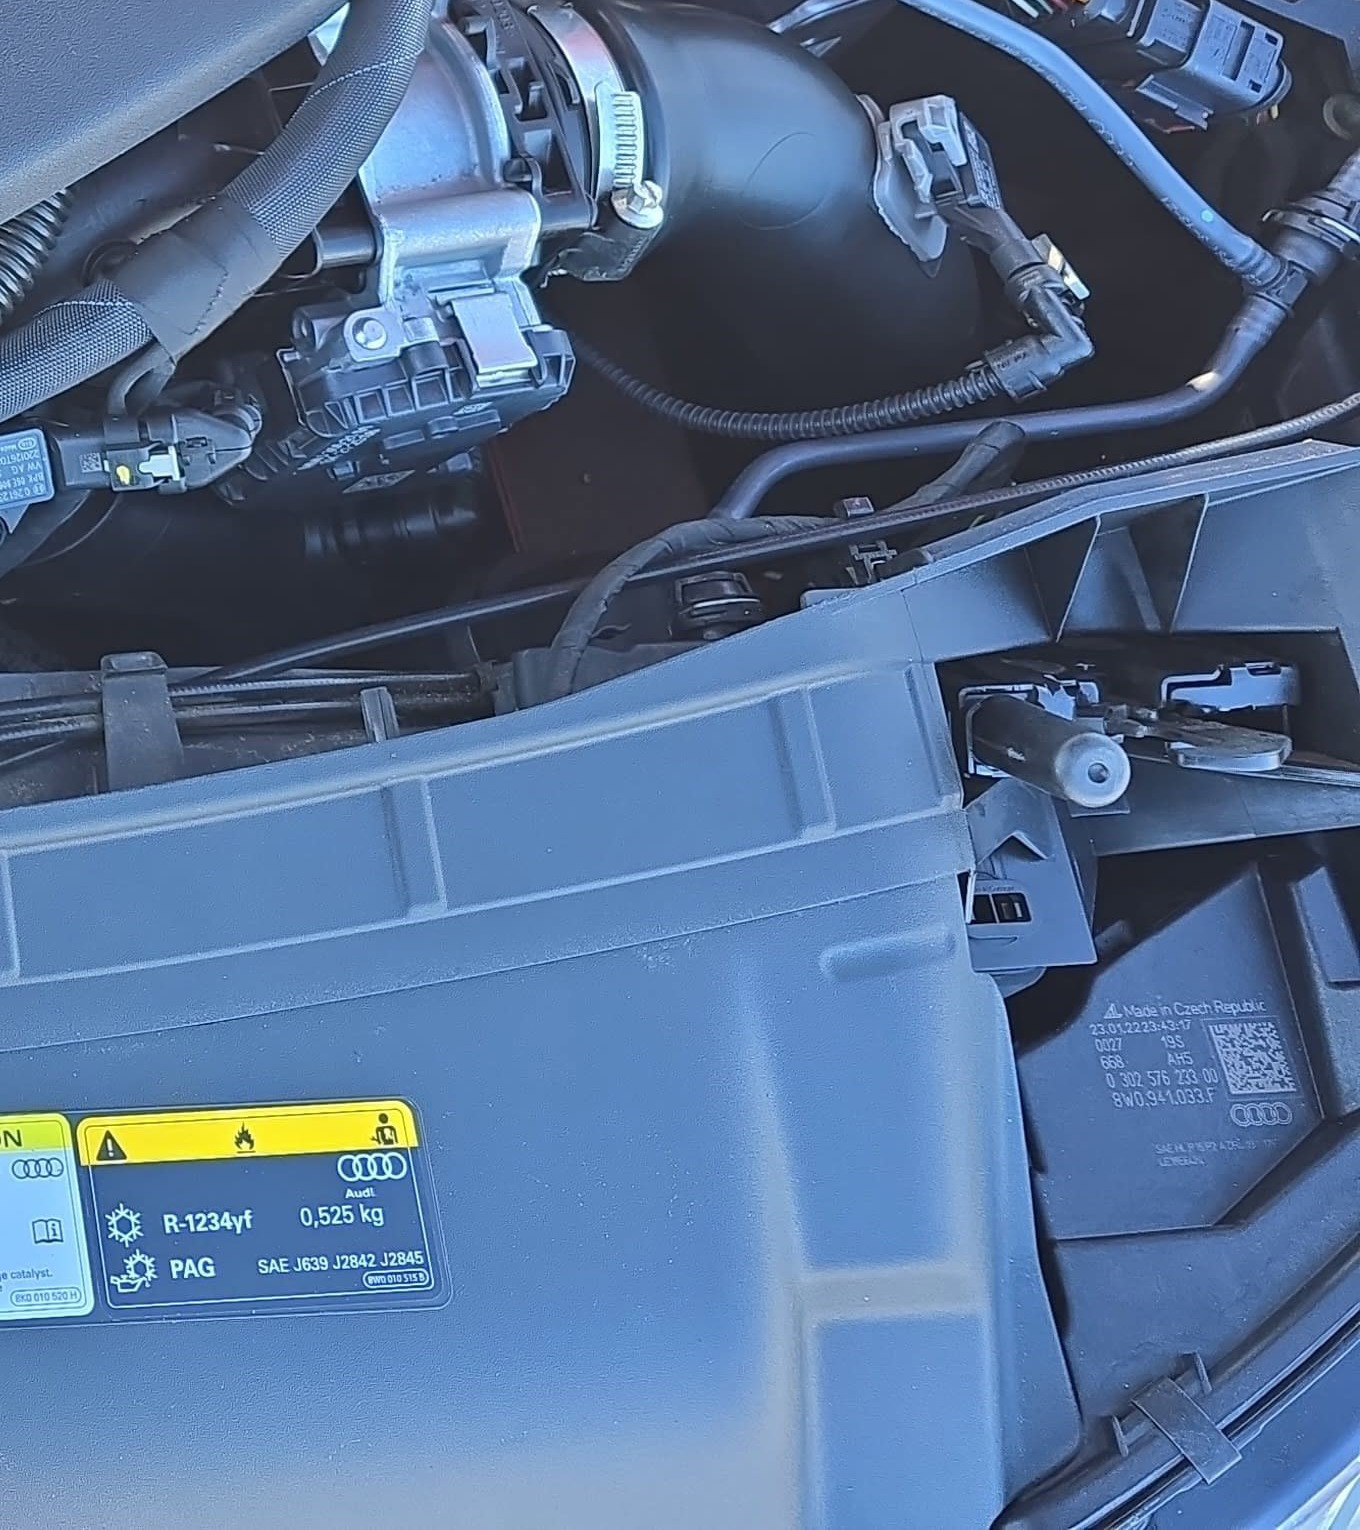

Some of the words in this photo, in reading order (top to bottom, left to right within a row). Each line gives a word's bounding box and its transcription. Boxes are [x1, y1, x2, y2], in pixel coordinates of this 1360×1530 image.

[1122, 1004, 1160, 1019] Made
[1173, 1000, 1213, 1017] Czech
[1212, 998, 1268, 1017] Republic
[1119, 1070, 1144, 1088] 302
[1146, 1069, 1172, 1087] 576
[1174, 1068, 1200, 1086] 233
[1202, 1067, 1220, 1084] 00
[344, 1186, 376, 1198] Audi
[162, 1208, 253, 1234] R-1234yf
[299, 1204, 354, 1228] 0,525
[358, 1202, 384, 1226] kg
[169, 1256, 216, 1279] PAG
[257, 1257, 290, 1274] SAE
[292, 1255, 328, 1272] J639
[332, 1252, 377, 1269] J2842
[379, 1249, 424, 1266] J2845
[9, 1267, 53, 1280] catalyst.
